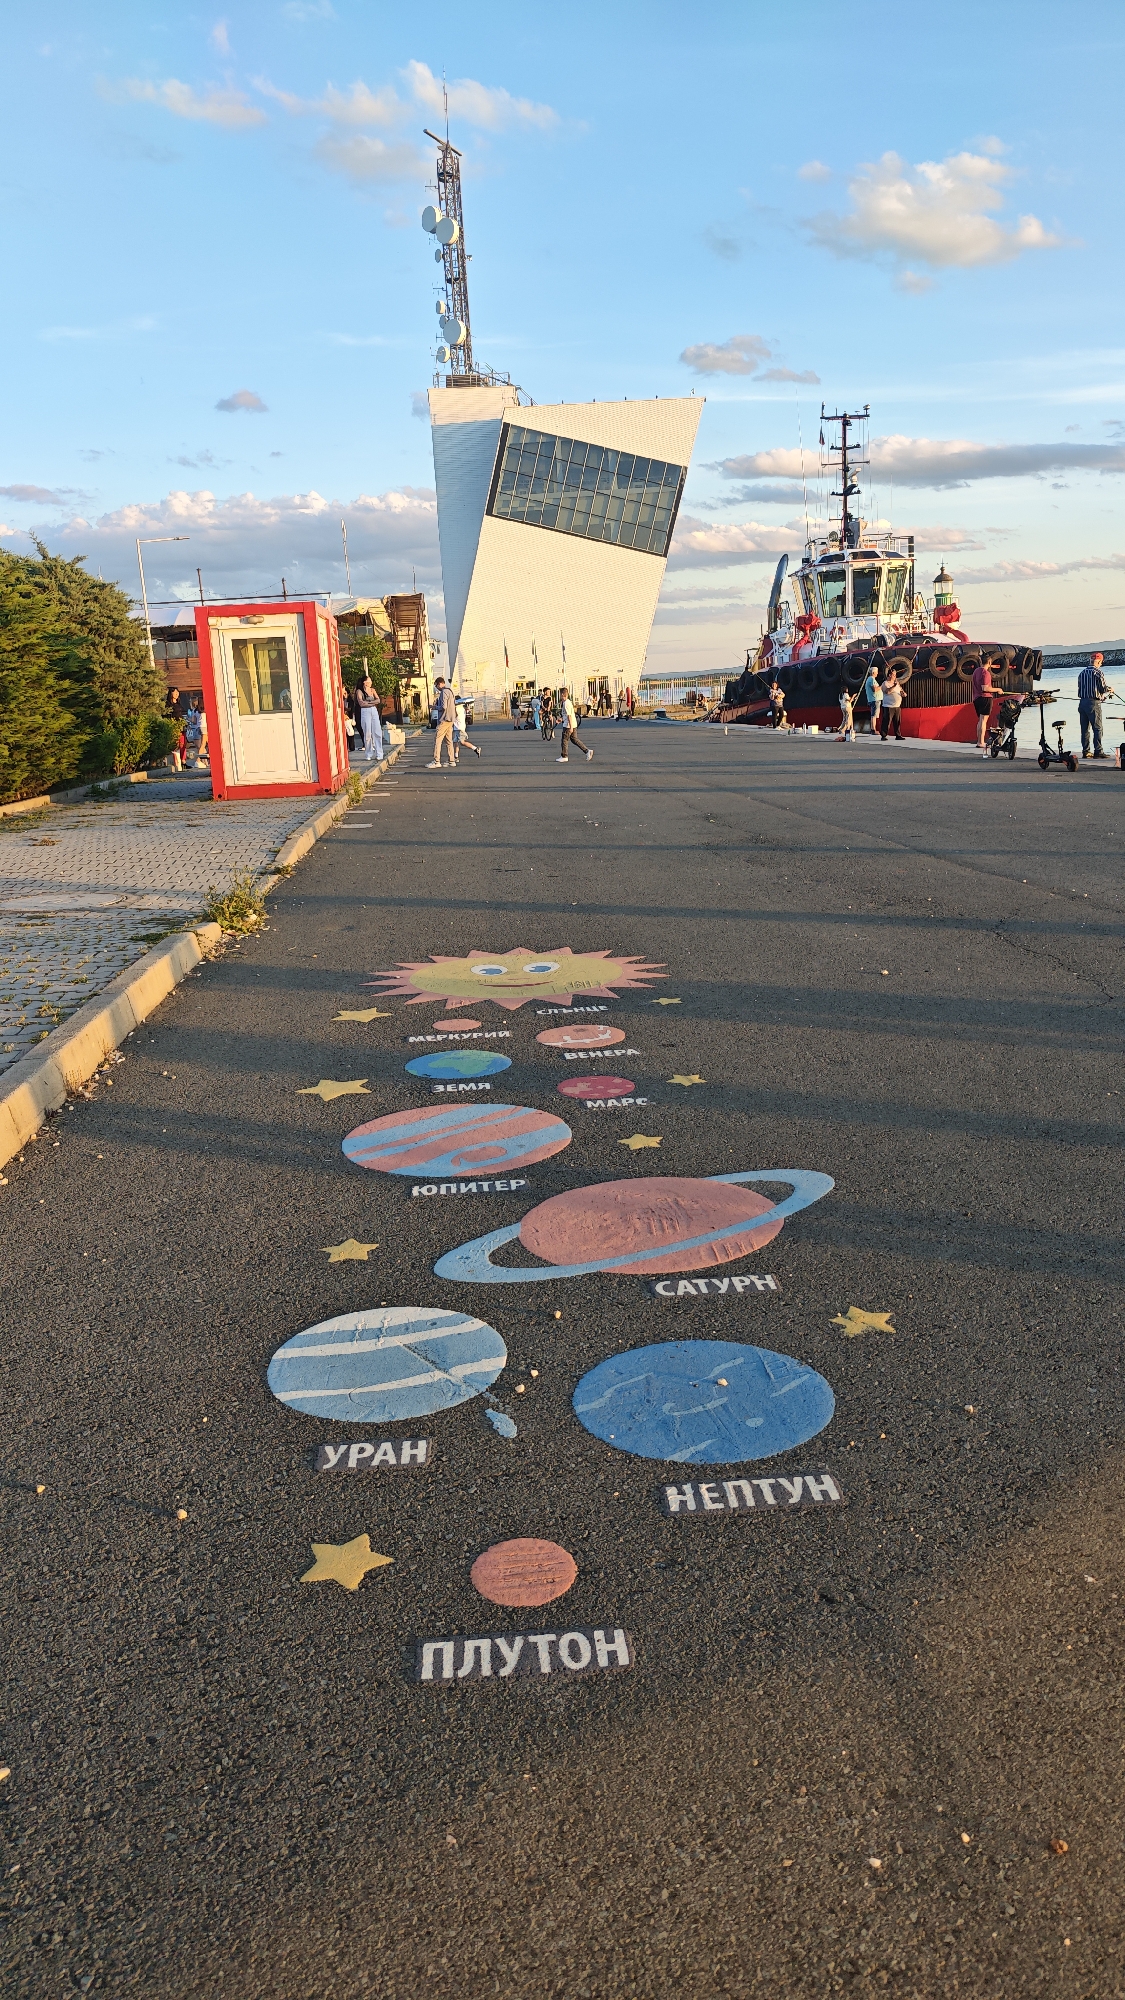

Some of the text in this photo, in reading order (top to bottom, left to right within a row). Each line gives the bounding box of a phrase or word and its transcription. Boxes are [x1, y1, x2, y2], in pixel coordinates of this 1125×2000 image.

[408, 1030, 511, 1043] МЕРКУРИЙ
[564, 1048, 640, 1060] ВЕНЕРА
[433, 1082, 491, 1093] ЗЕМЯ
[586, 1097, 648, 1109] МАРС
[411, 1179, 526, 1197] ЮПИТЕР
[654, 1274, 778, 1296] САТУРН
[323, 1439, 428, 1470] УРАН
[665, 1474, 841, 1512] НЕПТУН
[420, 1628, 630, 1680] ПЛУТОН
